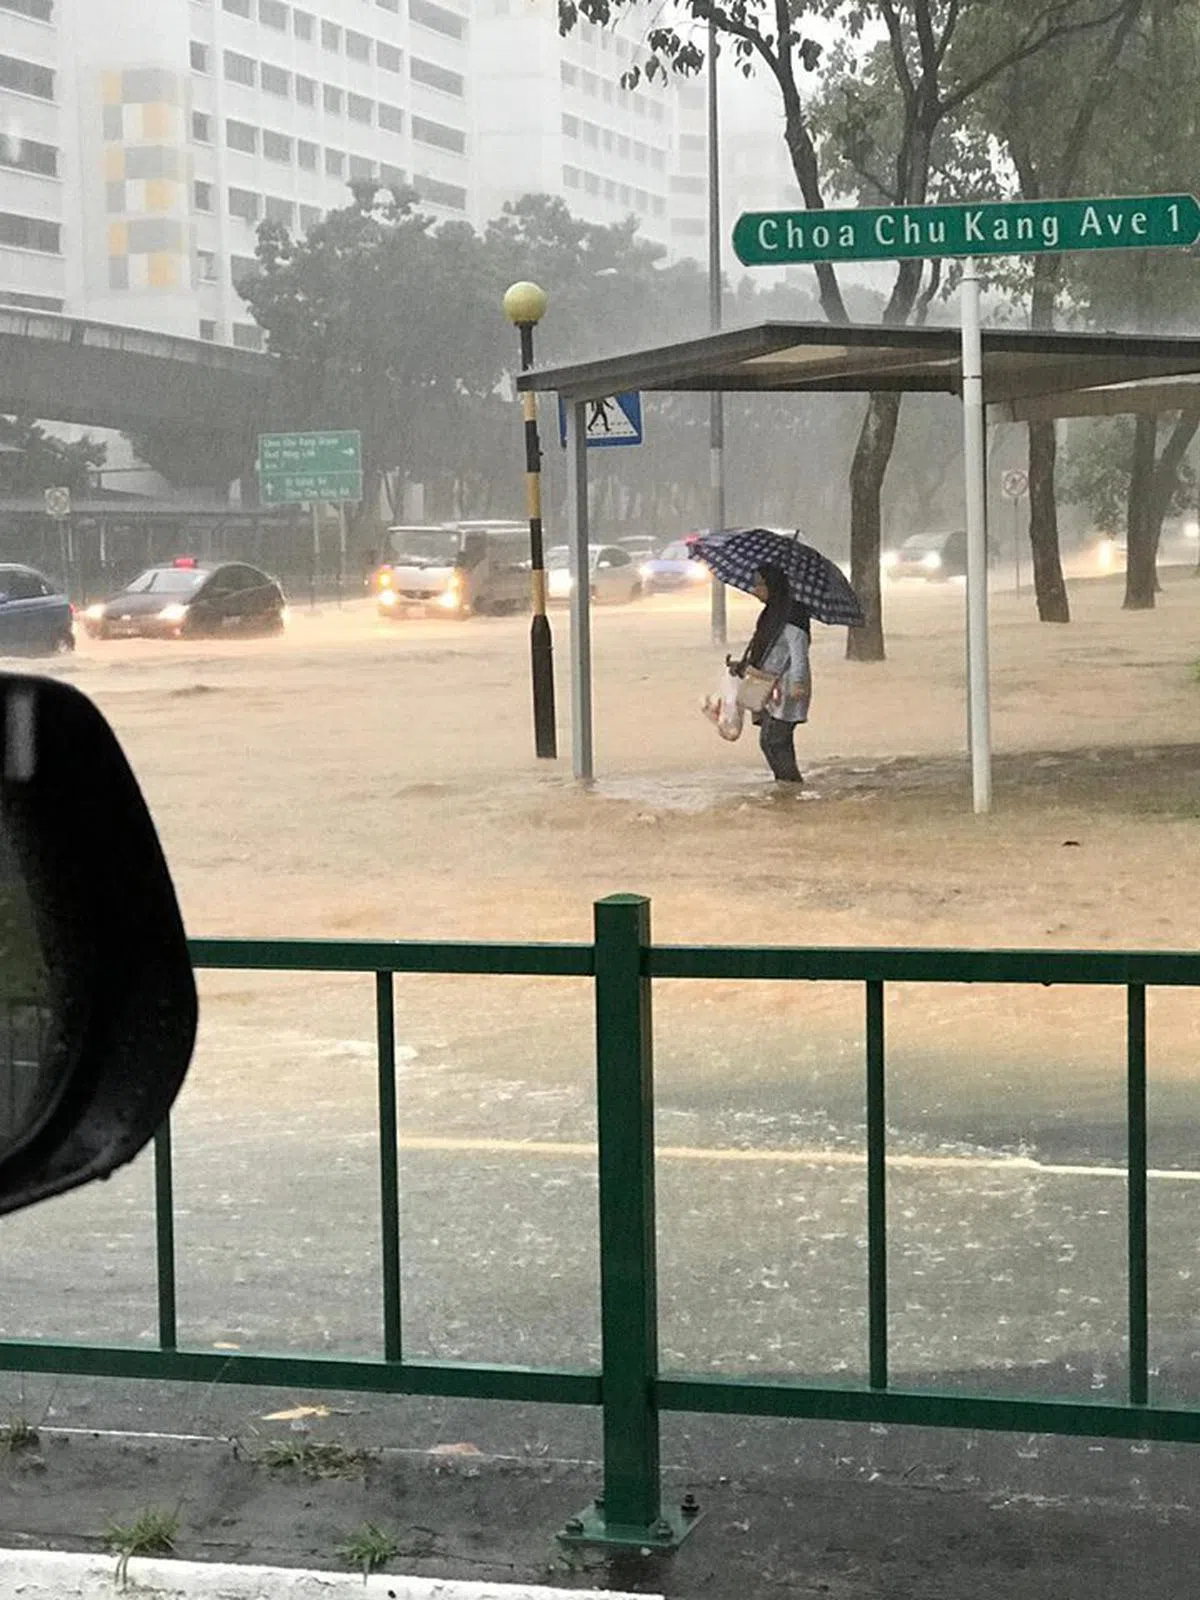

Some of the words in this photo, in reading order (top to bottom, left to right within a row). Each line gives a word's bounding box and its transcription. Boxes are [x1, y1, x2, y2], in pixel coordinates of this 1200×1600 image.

[758, 218, 854, 250] Choa
[875, 213, 945, 245] Chu
[965, 210, 1059, 247] Kang
[1080, 205, 1147, 237] Ave
[1167, 203, 1179, 232] 1
